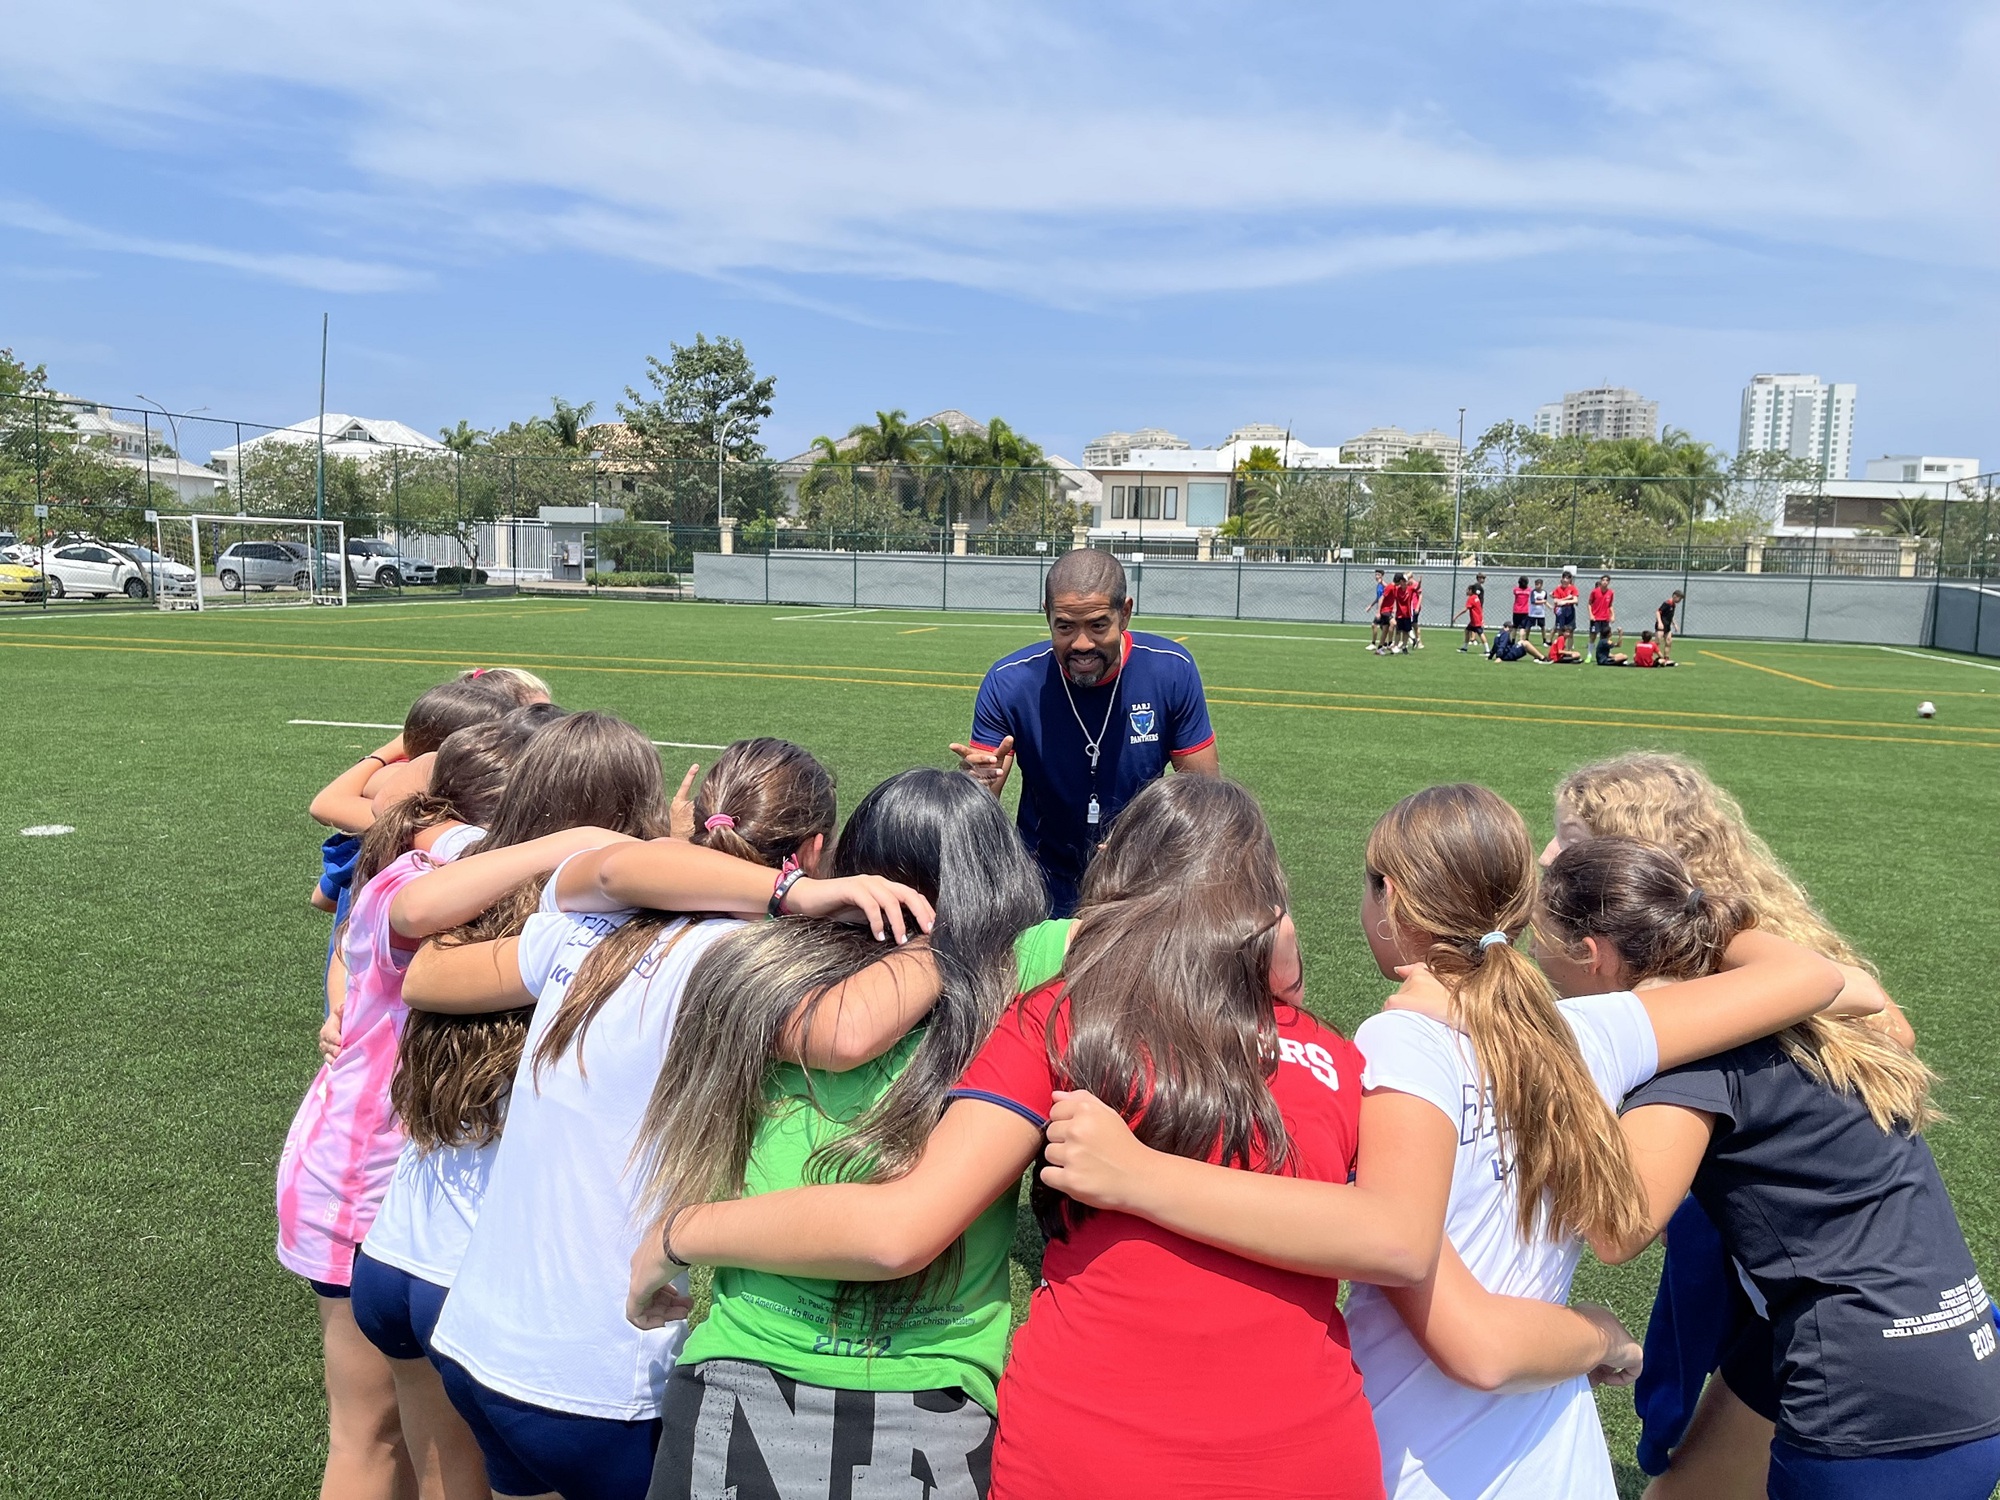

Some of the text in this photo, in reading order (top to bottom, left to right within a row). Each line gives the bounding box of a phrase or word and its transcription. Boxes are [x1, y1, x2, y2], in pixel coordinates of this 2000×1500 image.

[1130, 733, 1159, 744] PANTHERS
[755, 1298, 790, 1314] Americana
[791, 1306, 801, 1318] do
[802, 1310, 814, 1321] Rio
[815, 1313, 825, 1324] de
[825, 1316, 853, 1330] Jaeiro
[830, 1306, 856, 1321] Shool
[922, 1316, 953, 1326] Christian
